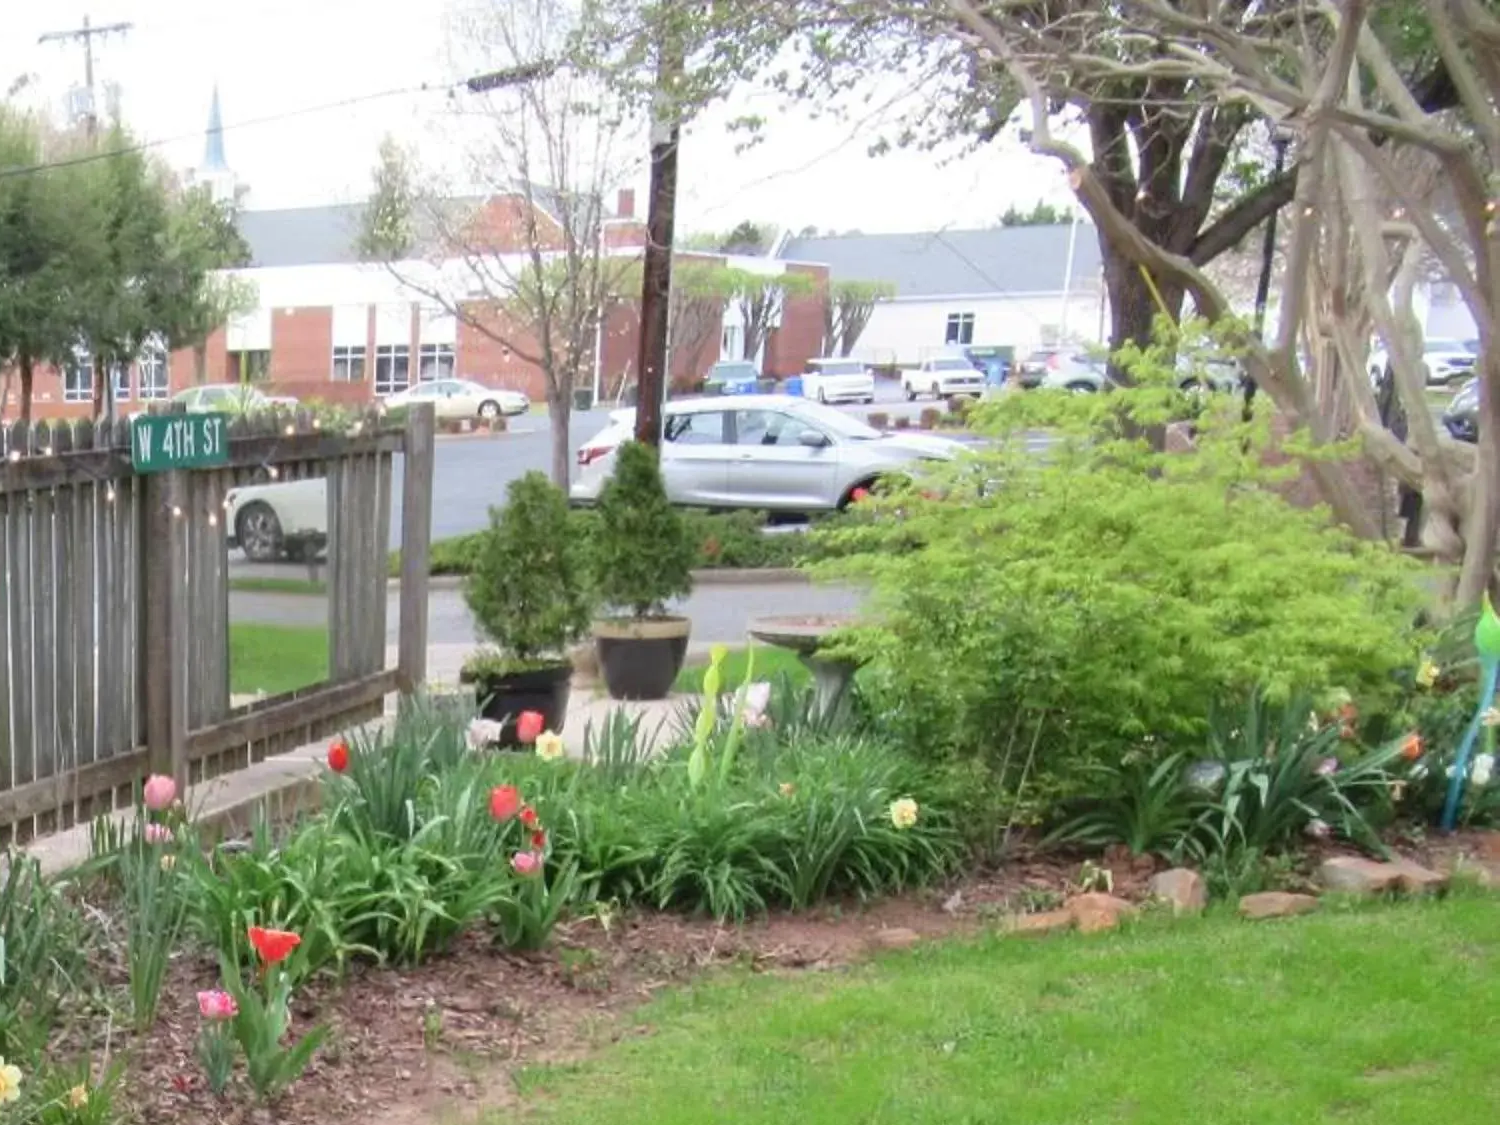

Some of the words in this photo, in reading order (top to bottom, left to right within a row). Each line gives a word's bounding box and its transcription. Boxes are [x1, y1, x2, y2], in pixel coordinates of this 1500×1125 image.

[138, 424, 152, 463] W
[163, 419, 195, 459] 4TH
[203, 418, 222, 456] ST
